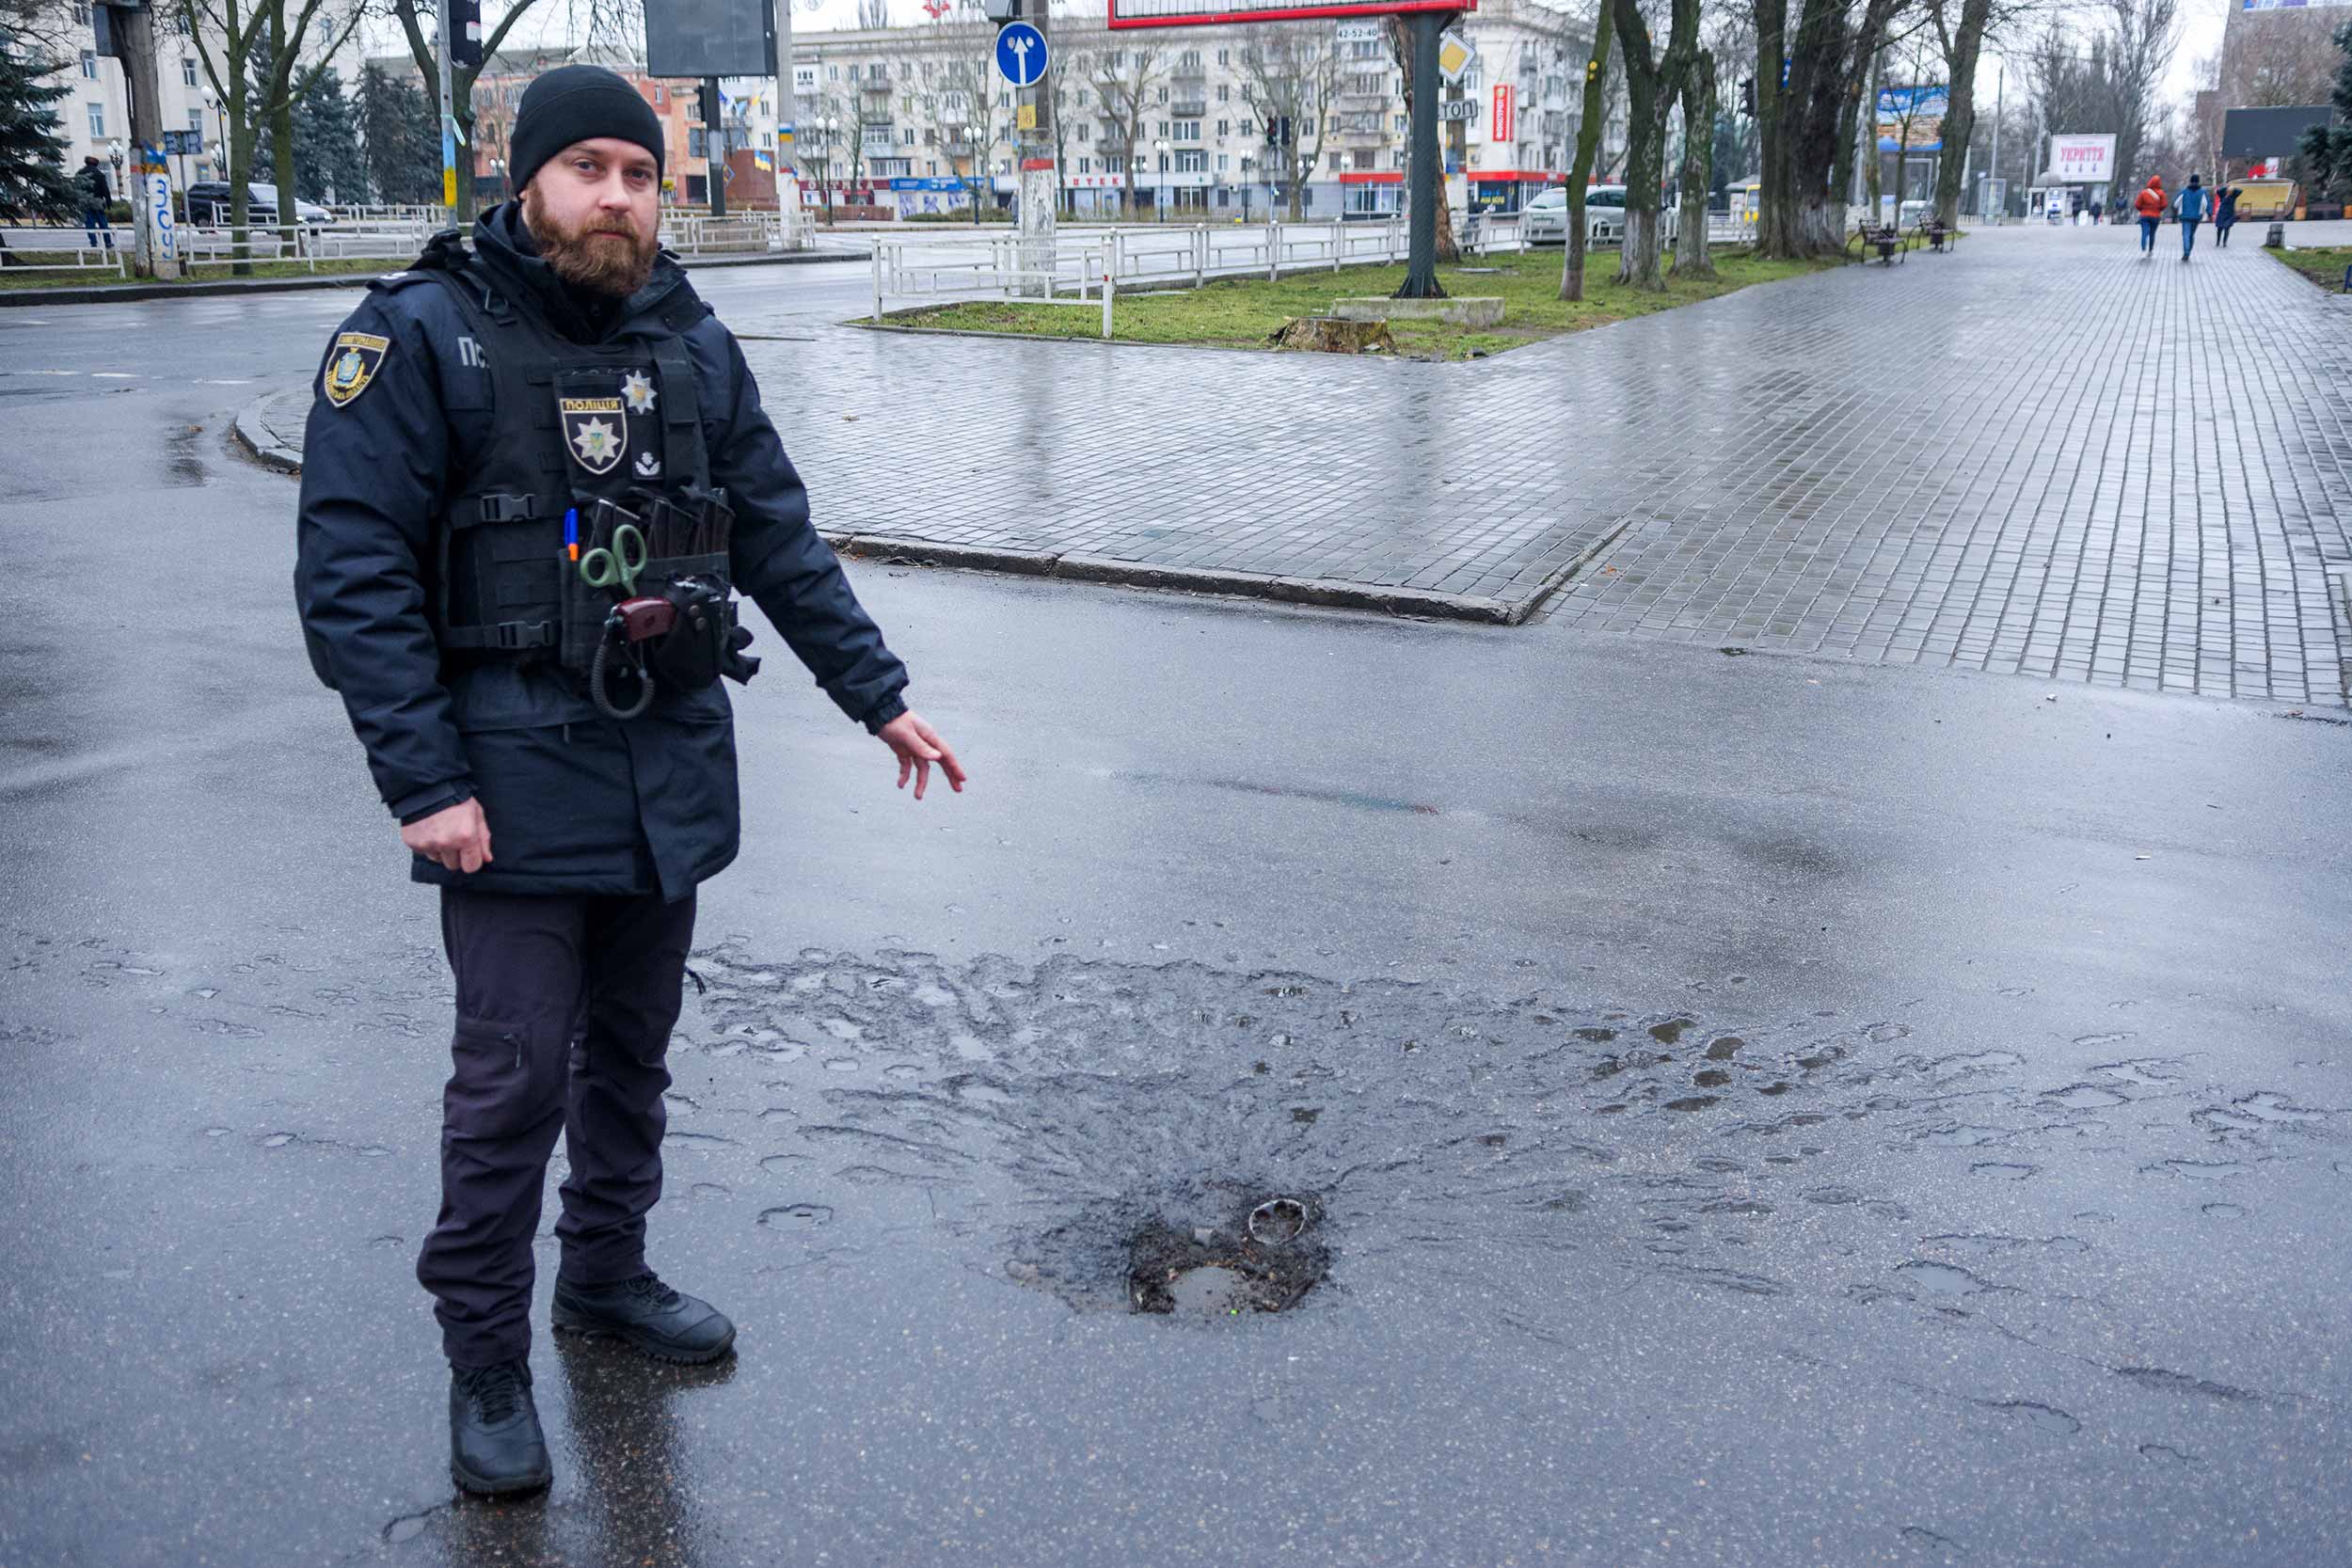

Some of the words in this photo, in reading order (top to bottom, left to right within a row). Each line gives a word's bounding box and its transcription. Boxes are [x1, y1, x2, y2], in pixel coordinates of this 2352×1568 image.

[1339, 28, 1377, 38] 42-52-40
[2060, 147, 2105, 162] УКРИТТЯ
[565, 400, 619, 410] ПОЛІЦІЯ
